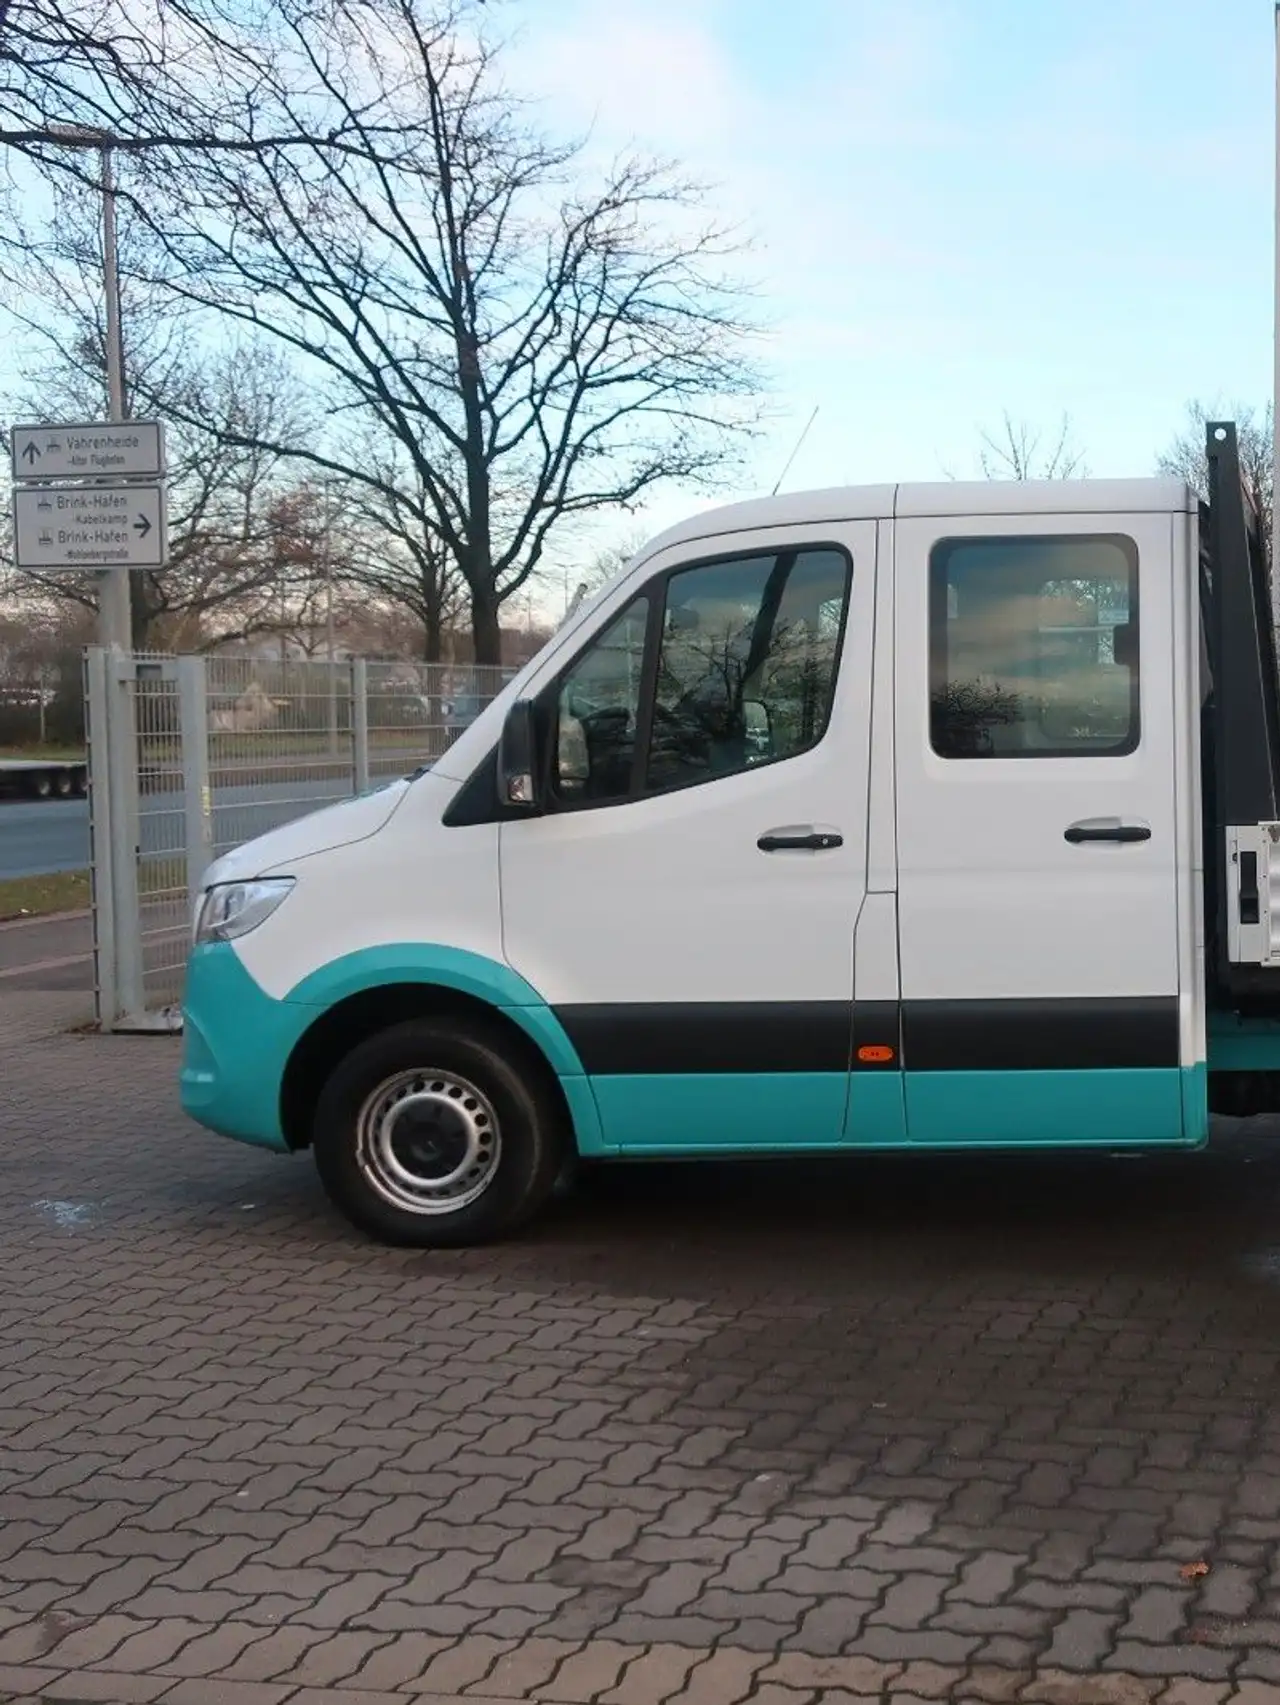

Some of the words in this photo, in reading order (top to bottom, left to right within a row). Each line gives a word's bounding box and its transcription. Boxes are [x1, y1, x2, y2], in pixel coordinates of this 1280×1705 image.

[67, 435, 139, 449] Vahrenheide
[57, 495, 128, 509] Brink-Hafen
[58, 530, 129, 544] Brink-Hafen
